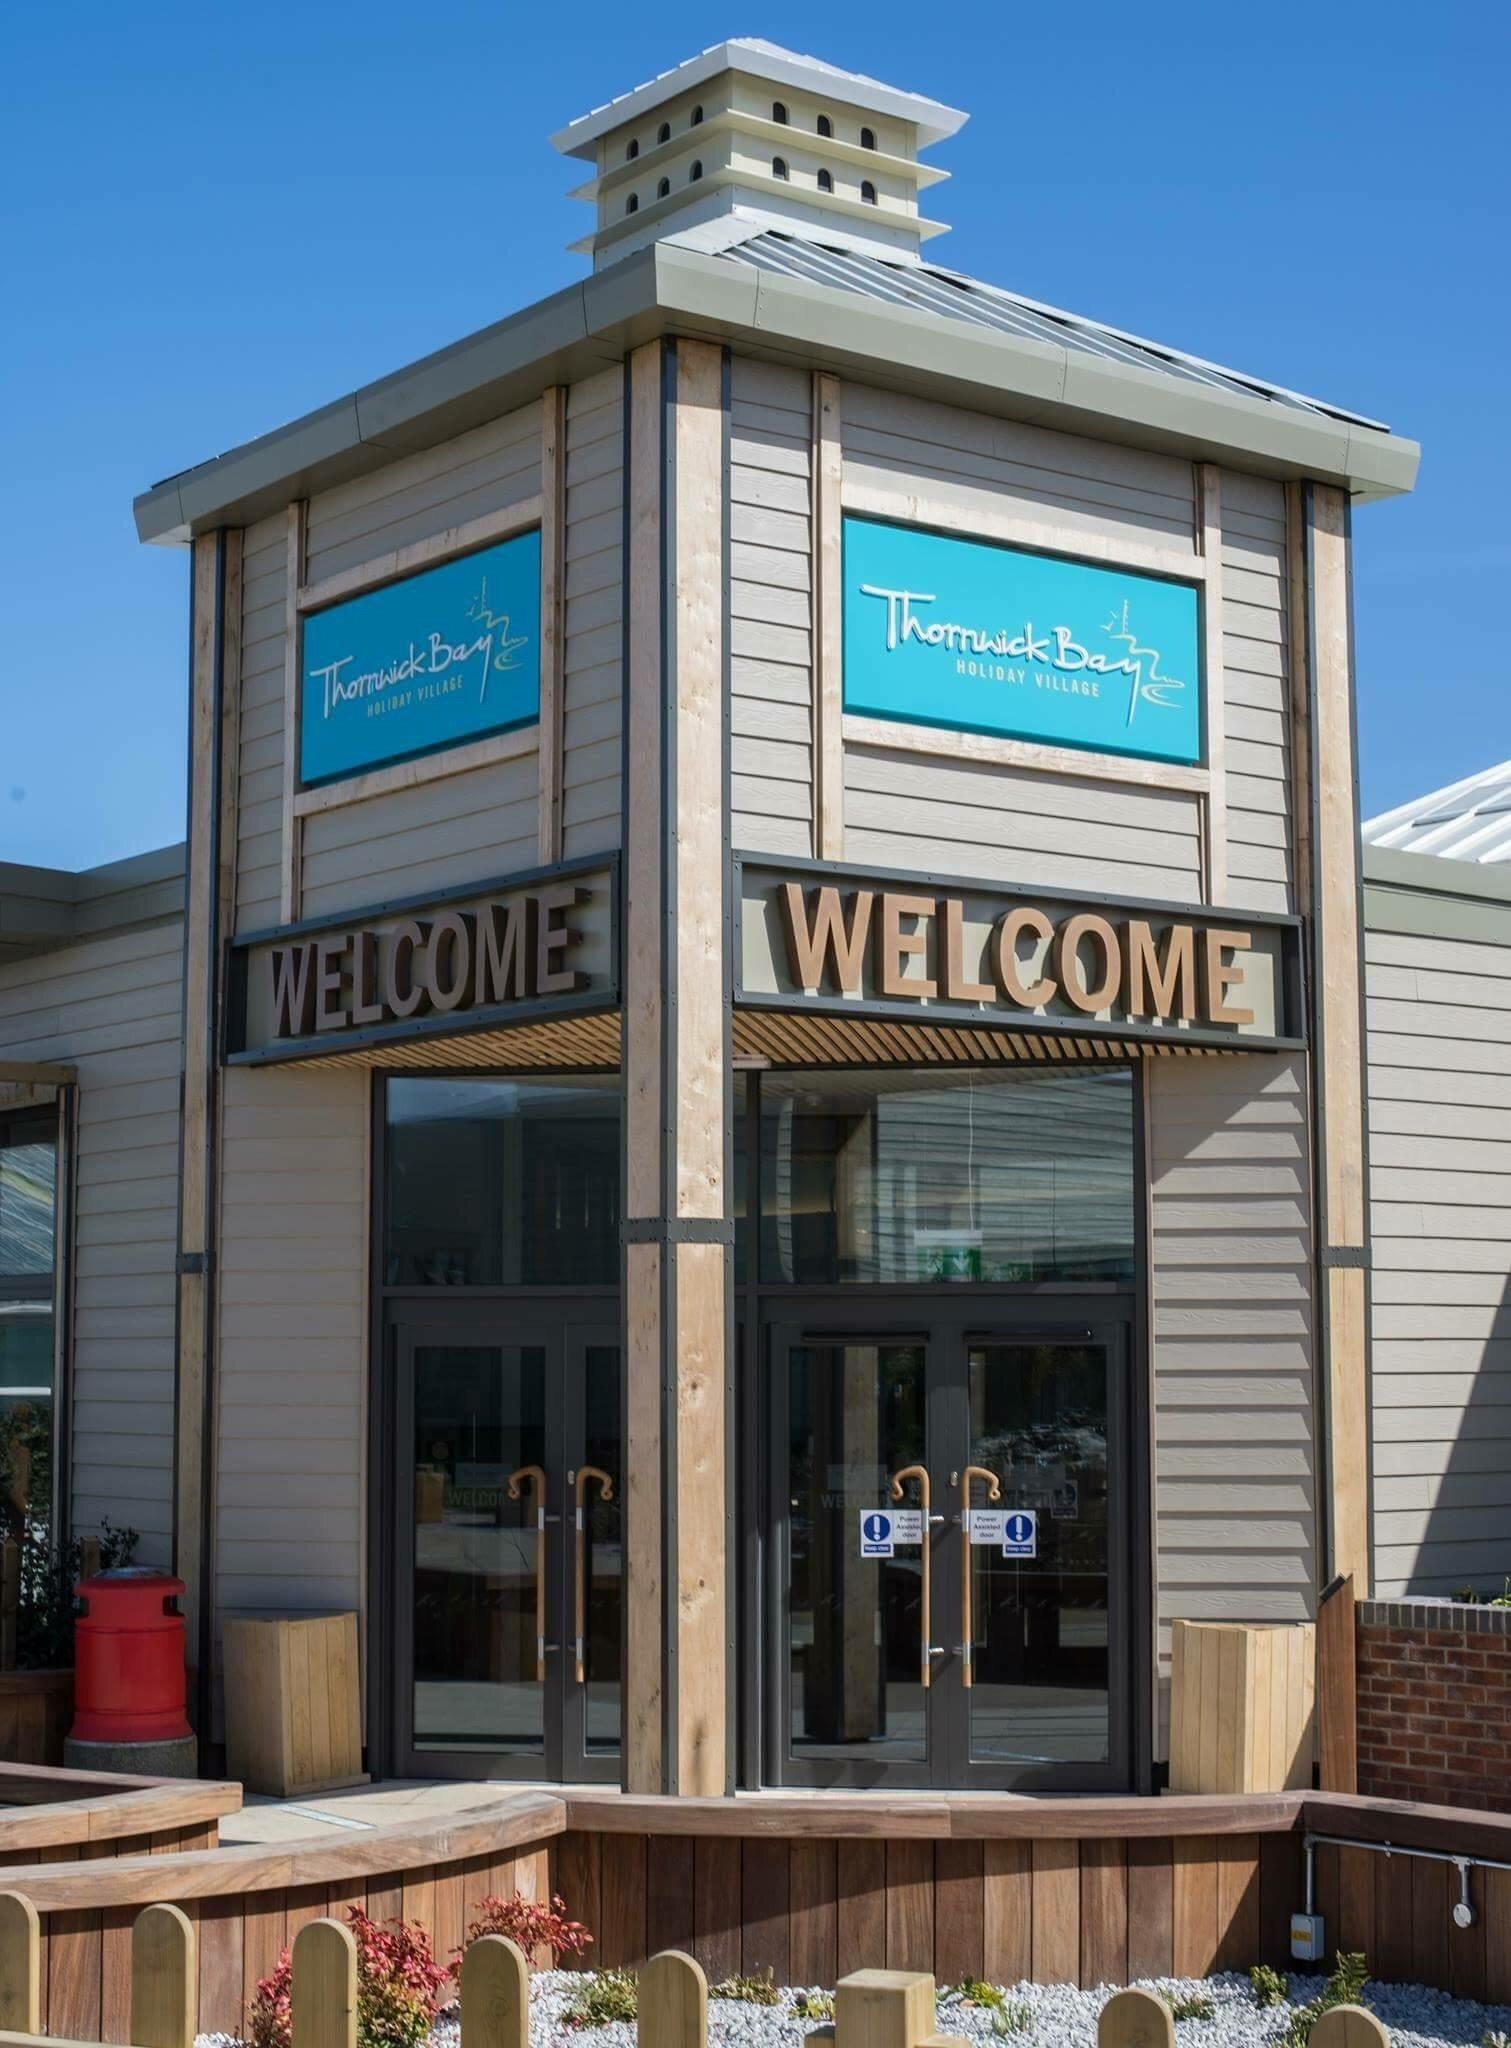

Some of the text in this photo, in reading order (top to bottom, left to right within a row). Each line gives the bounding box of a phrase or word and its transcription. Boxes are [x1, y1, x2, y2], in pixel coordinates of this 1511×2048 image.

[309, 631, 493, 719] Thornwick Bay
[367, 675, 464, 717] HOLIDAY VILLAGE
[859, 584, 1142, 728] Thornwick Bay
[956, 660, 1101, 697] HOLIDAY VILLAGE
[266, 887, 592, 1038] WELCOME
[778, 882, 1255, 1025] WELCOME
